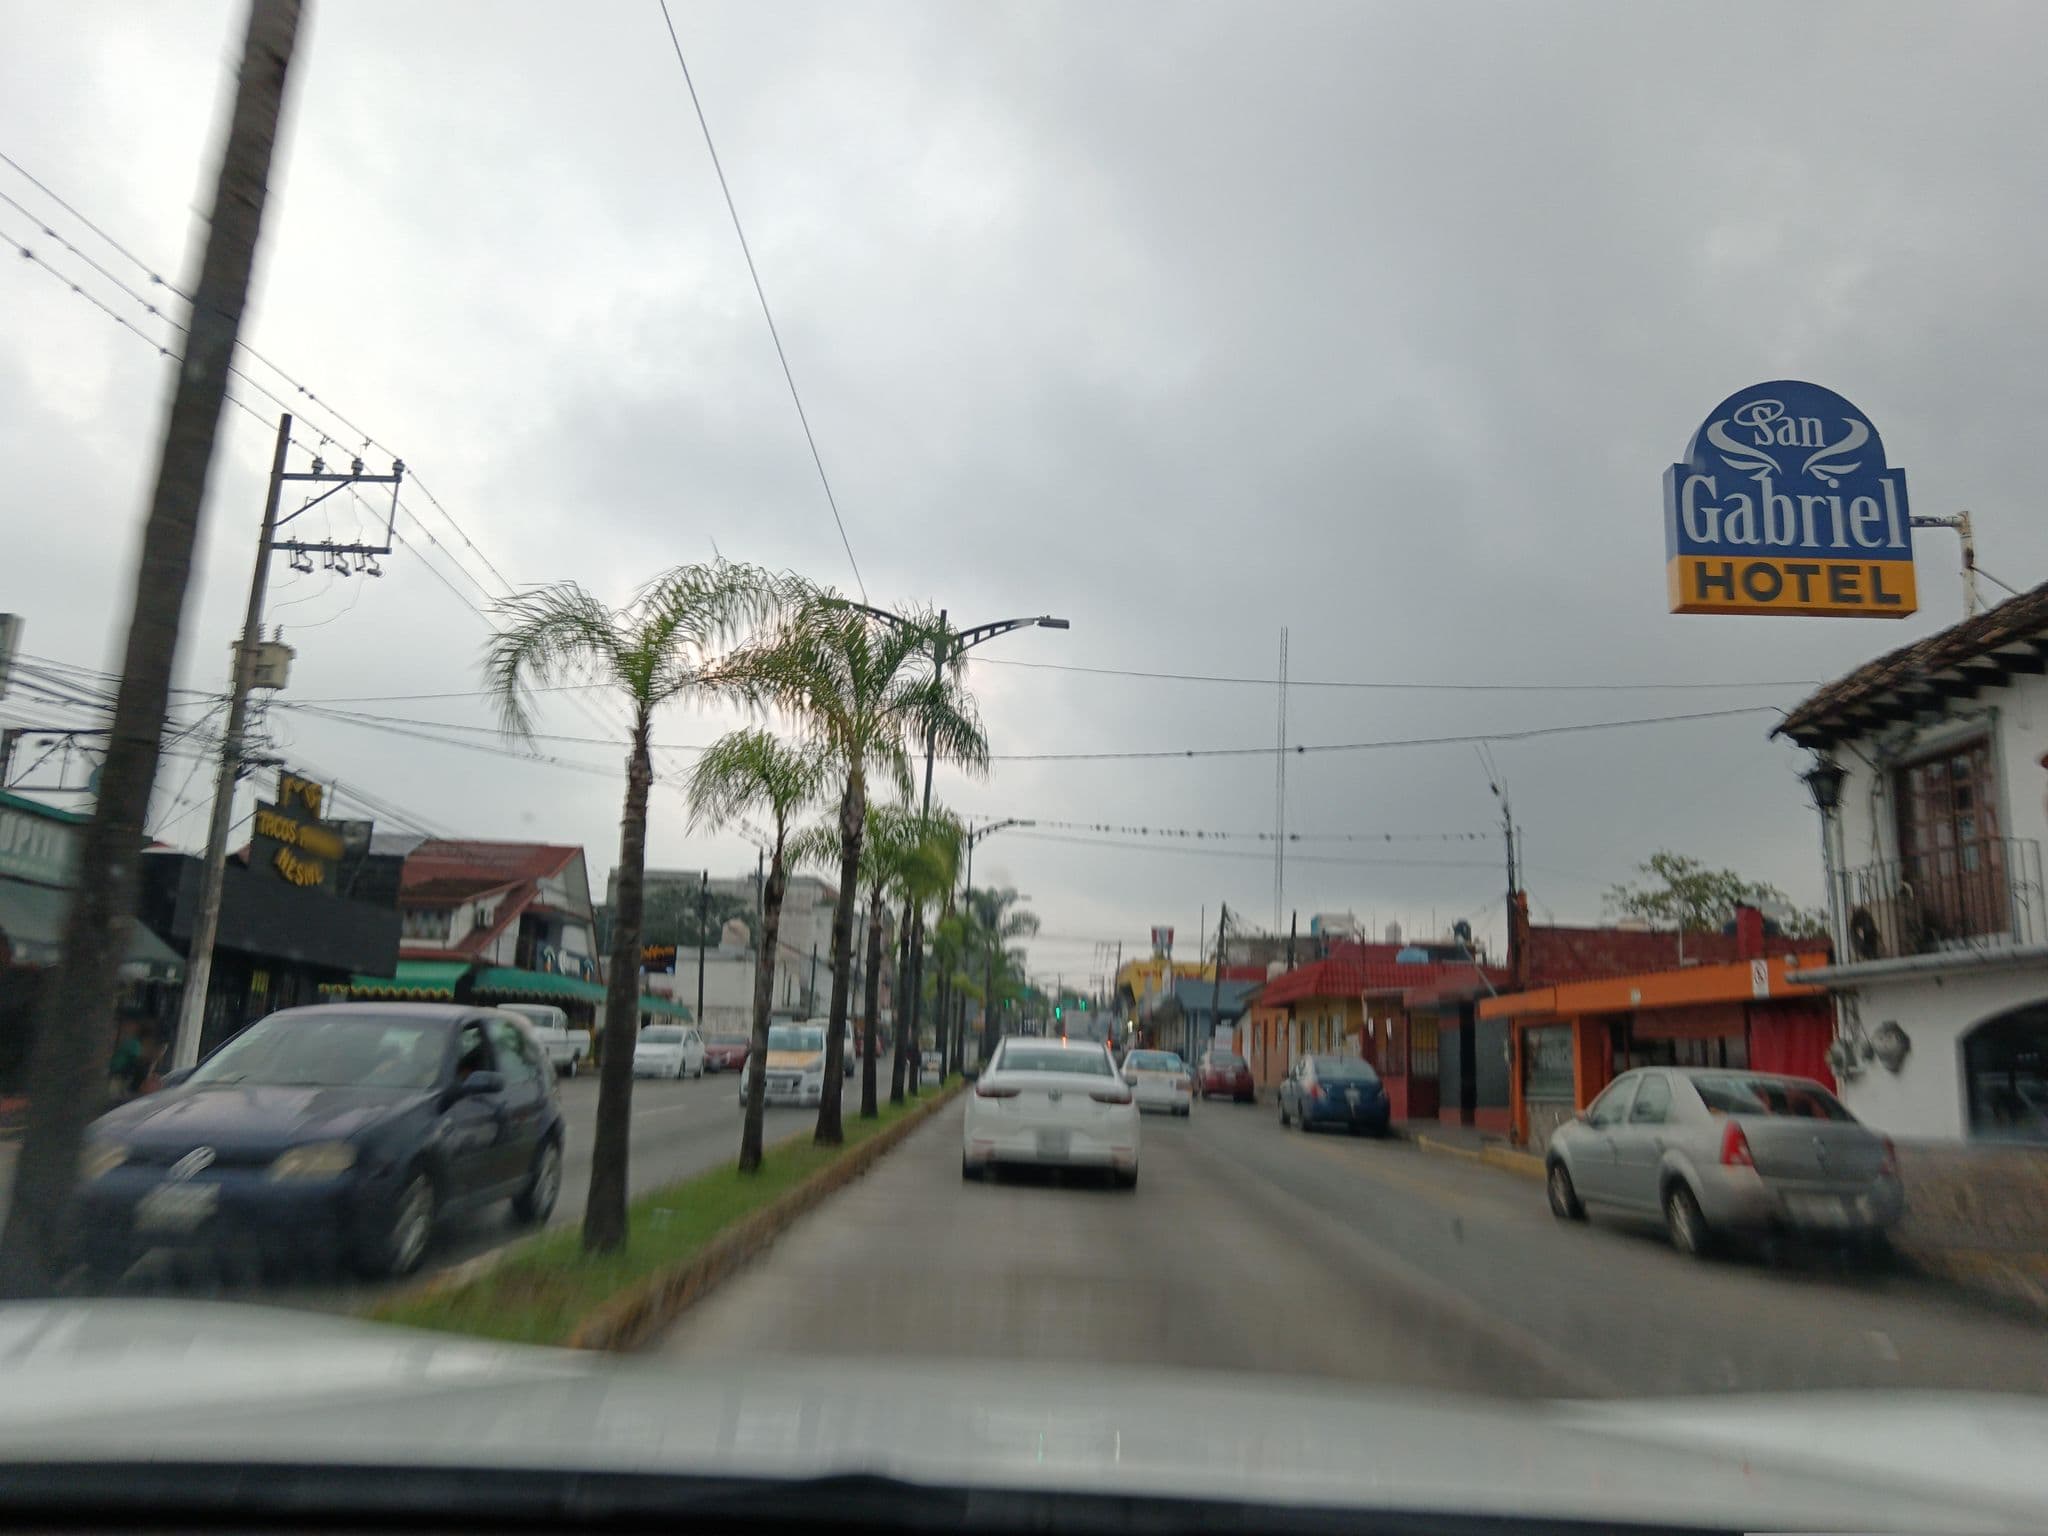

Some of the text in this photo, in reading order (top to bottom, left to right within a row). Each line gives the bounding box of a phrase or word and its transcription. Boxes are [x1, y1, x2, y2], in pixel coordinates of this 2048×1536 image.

[1736, 400, 1826, 448] San
[1681, 474, 1907, 549] Gabriel
[1694, 561, 1902, 605] HOTEL
[256, 810, 297, 844] TACOS
